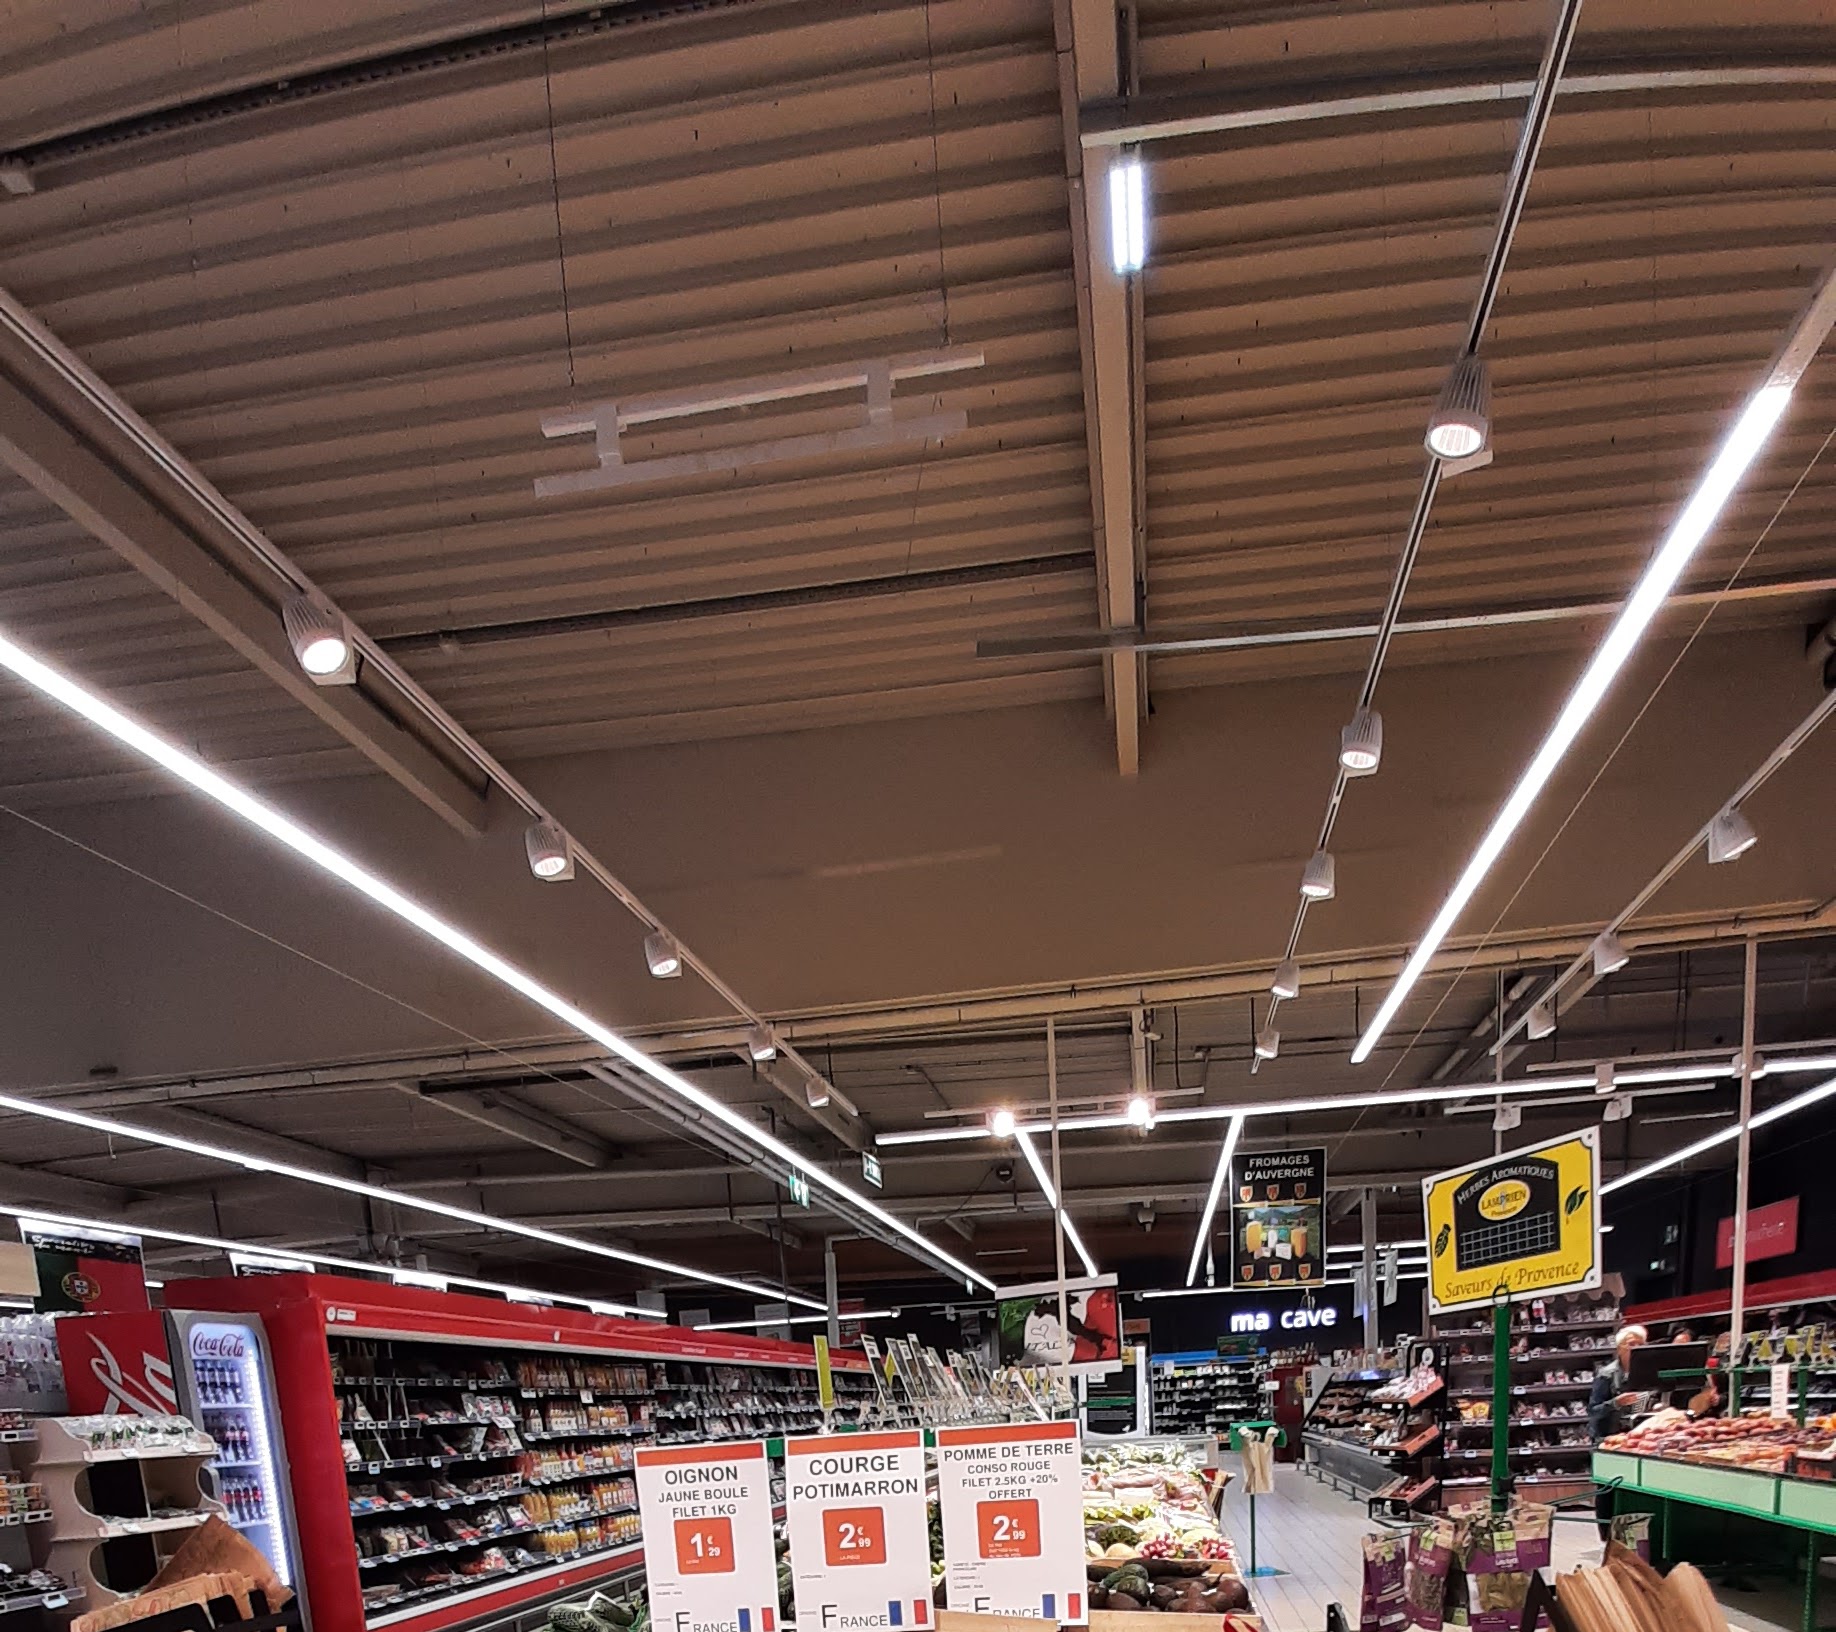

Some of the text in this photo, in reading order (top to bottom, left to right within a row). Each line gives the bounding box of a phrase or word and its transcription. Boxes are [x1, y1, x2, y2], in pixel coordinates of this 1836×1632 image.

[1249, 1155, 1310, 1168] FROMAGES
[1244, 1167, 1314, 1181] D'AUVERGNE
[1457, 1177, 1490, 1205] HERBES
[1445, 1279, 1493, 1299] Saveurs
[1514, 1262, 1580, 1286] Provence
[1230, 1307, 1337, 1332] ma cave
[944, 1442, 1074, 1461] POMME DE TERRE
[809, 1455, 899, 1475] COURGE
[967, 1460, 1051, 1474] CONSO ROUGE
[665, 1466, 738, 1485] OIGNON
[962, 1474, 1059, 1487] FILET 2.5KG +20%
[658, 1486, 749, 1503] JAUNE BOULE
[793, 1478, 918, 1500] POTIMARRON
[988, 1488, 1032, 1500] OFFERT
[672, 1504, 737, 1518] FILET 1KG
[821, 1604, 888, 1628] FRANCE
